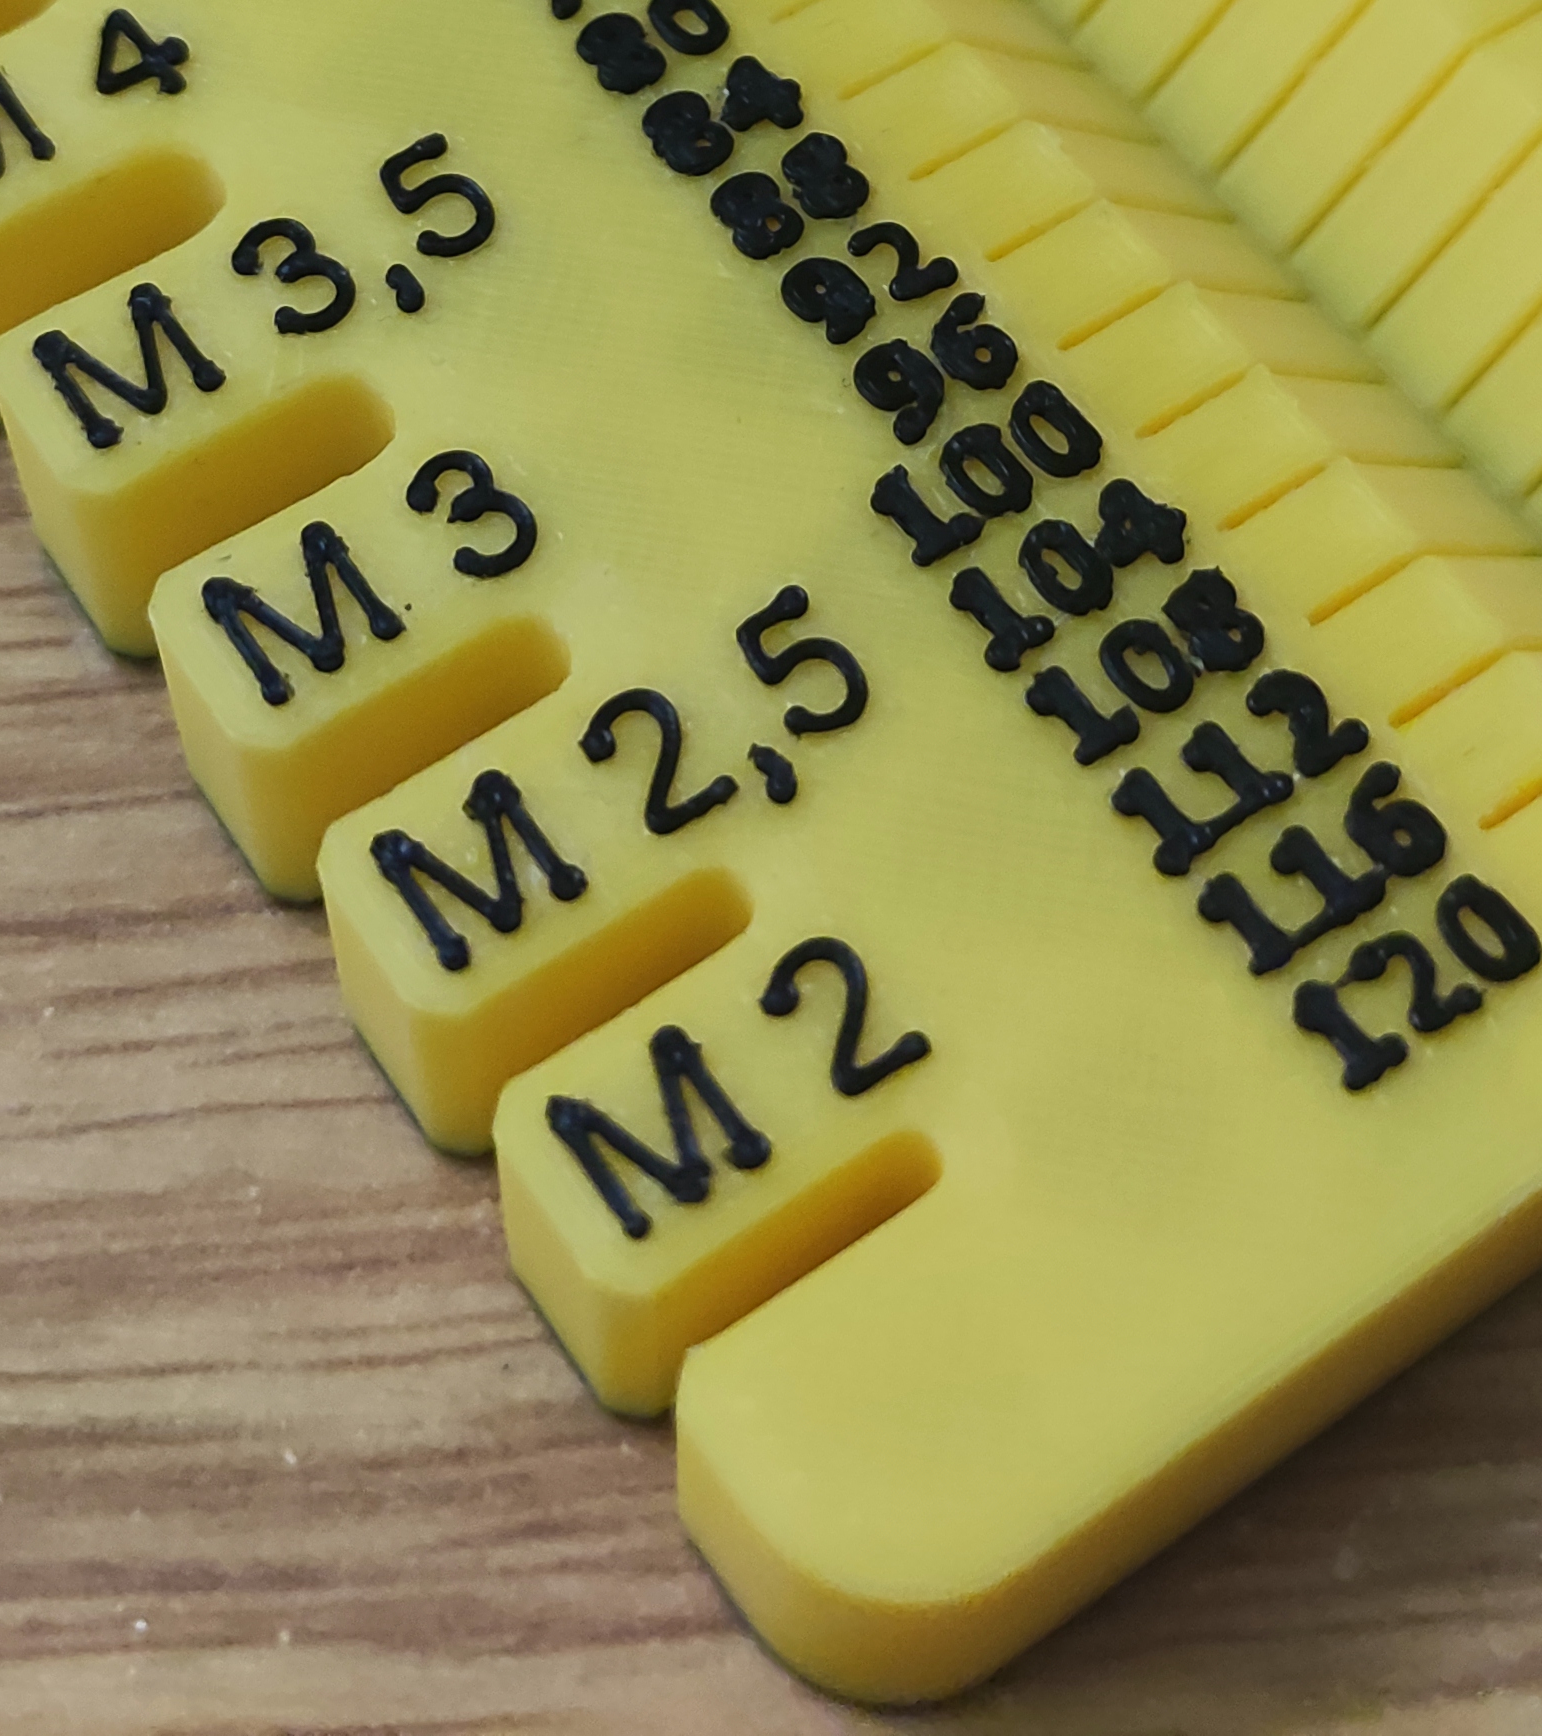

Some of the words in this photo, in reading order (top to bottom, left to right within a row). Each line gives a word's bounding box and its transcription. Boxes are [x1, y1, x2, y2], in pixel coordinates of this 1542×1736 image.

[95, 7, 191, 97] 4
[641, 54, 804, 177] 84
[32, 281, 226, 448] M
[231, 132, 495, 336] 3,5
[709, 131, 870, 260] 88
[780, 220, 960, 345] 92
[852, 291, 1019, 446] 96
[869, 379, 1103, 567] 100
[200, 520, 404, 707] M
[405, 450, 537, 578] 3
[949, 478, 1187, 673] 104
[1024, 567, 1265, 767] 108
[369, 768, 587, 973] M
[577, 584, 869, 834] 2,5
[1110, 668, 1369, 877] 112
[1196, 760, 1447, 978] 116
[545, 1023, 772, 1241] M
[758, 935, 932, 1097] 2
